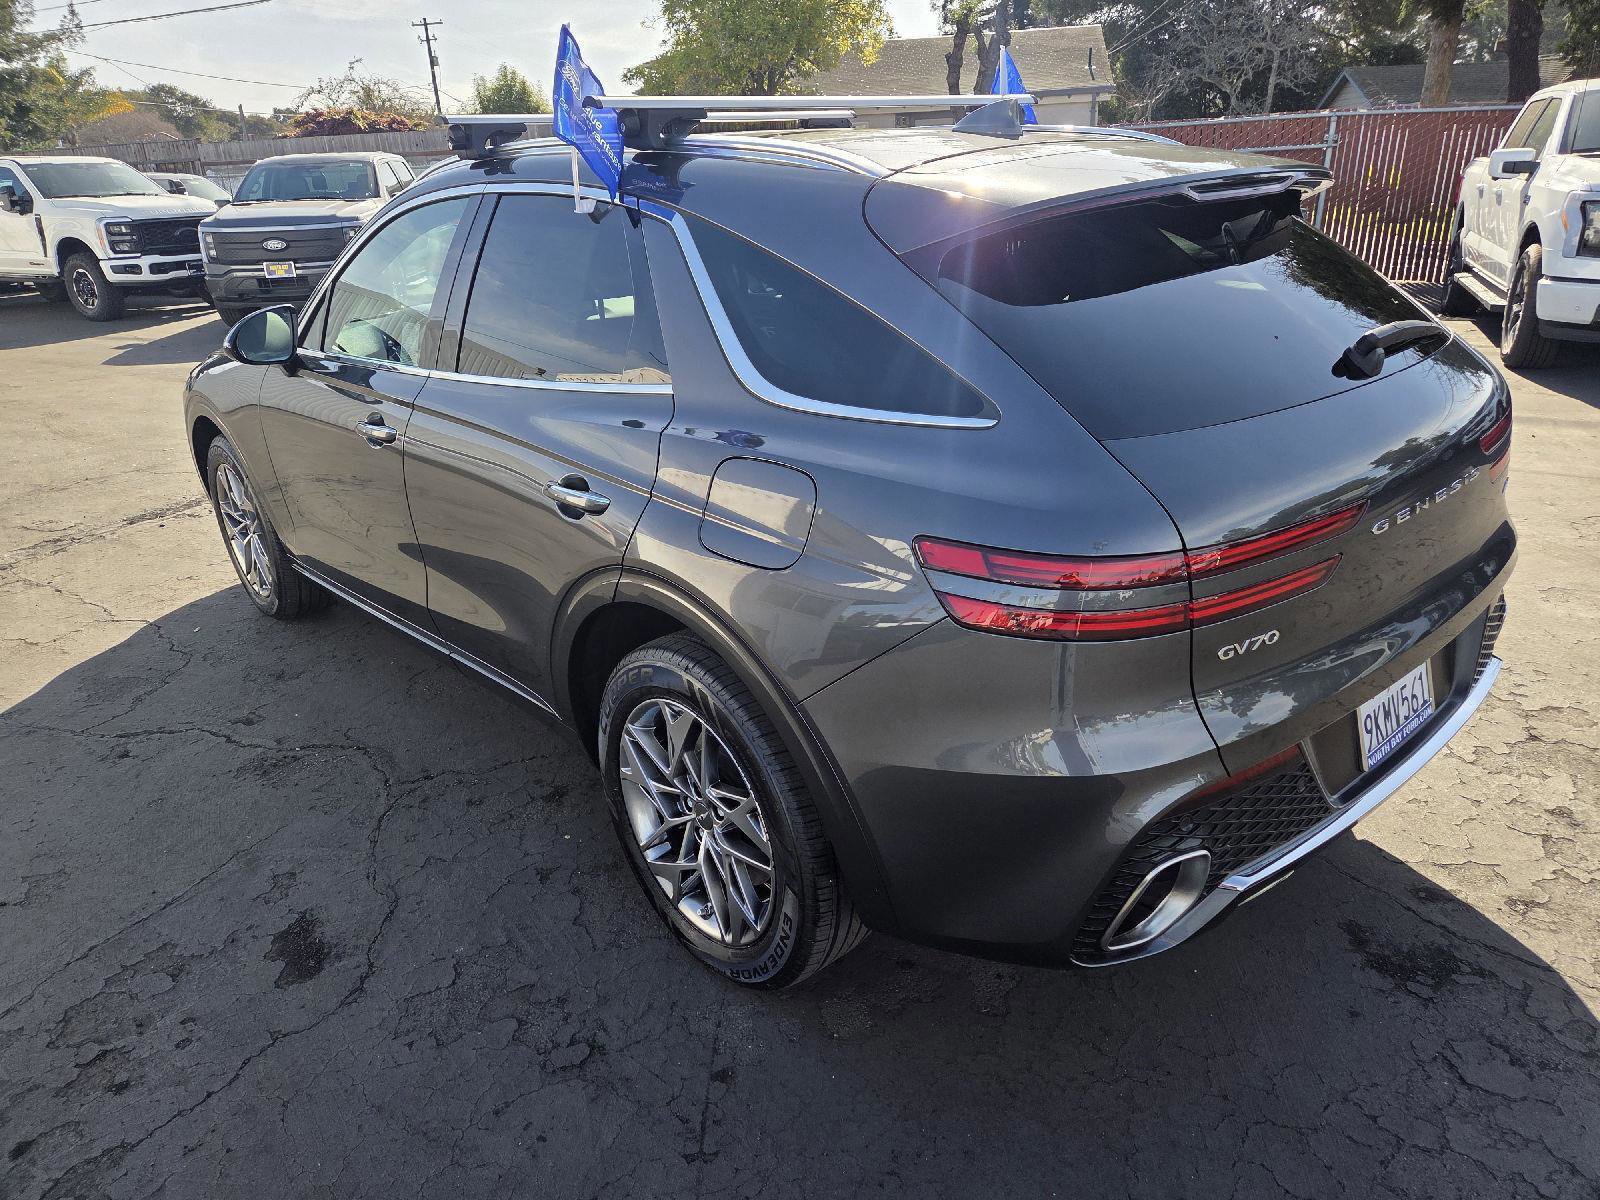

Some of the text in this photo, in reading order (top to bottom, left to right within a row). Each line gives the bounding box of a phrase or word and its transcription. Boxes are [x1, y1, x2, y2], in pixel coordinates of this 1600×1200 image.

[562, 65, 579, 92] Ford
[1371, 467, 1481, 535] GENESIS
[1217, 629, 1280, 660] GV70
[1363, 670, 1429, 753] 9KMV561
[1368, 741, 1390, 768] NORTH
[1390, 730, 1403, 749] BAY
[729, 911, 793, 980] ENDEAVOR
